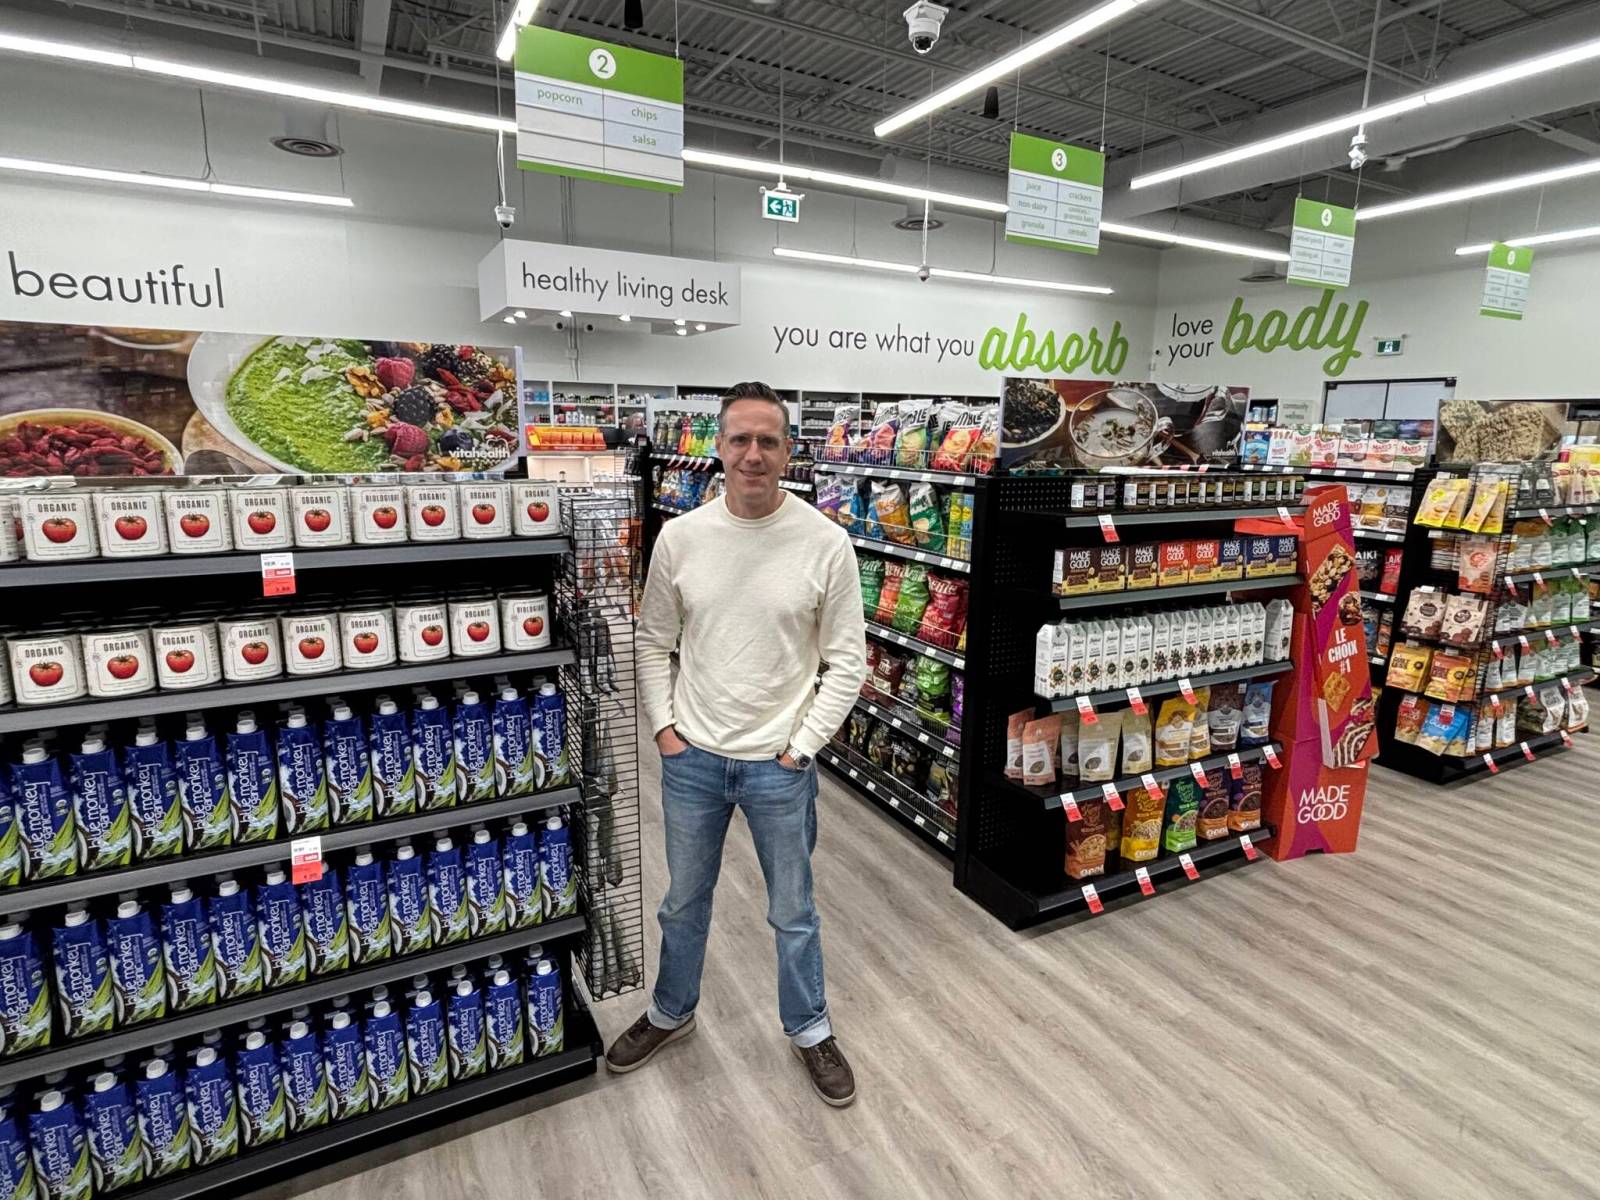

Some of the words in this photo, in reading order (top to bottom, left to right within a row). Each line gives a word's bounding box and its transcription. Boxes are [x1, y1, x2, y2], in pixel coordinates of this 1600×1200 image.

[596, 54, 609, 74] 2
[537, 87, 584, 106] popcorn
[631, 106, 658, 122] chips
[632, 132, 657, 147] salsa
[1055, 152, 1064, 167] 3
[8, 250, 225, 309] beautiful
[522, 261, 609, 302] healthy
[617, 270, 673, 308] living
[681, 278, 729, 306] desk
[1172, 313, 1213, 338] love
[1221, 288, 1370, 377] body
[773, 325, 819, 354] you
[828, 328, 868, 350] are
[875, 323, 931, 356] what
[937, 337, 975, 364] you
[978, 311, 1130, 376] absorb
[1168, 338, 1215, 367] your
[448, 446, 511, 459] vitahealth
[176, 499, 211, 510] ORGANIC
[244, 497, 276, 507] ORGANIC
[301, 495, 332, 505] ORGANIC
[418, 492, 447, 501] ORGANIC
[470, 491, 497, 500] ORGANIC
[525, 489, 551, 498] ORGANIC
[38, 503, 77, 513] ORGANIC
[110, 500, 148, 511] ORGANIC
[1312, 499, 1340, 518] MADE
[1313, 510, 1341, 527] GOOD
[1135, 546, 1153, 556] MADE
[1166, 544, 1184, 553] MADE
[1196, 542, 1214, 551] MADE
[1223, 540, 1240, 549] MADE
[1223, 547, 1240, 557] GOOD
[1252, 538, 1269, 547] MADE
[1252, 545, 1269, 555] GOOD
[1278, 537, 1295, 545] MADE
[1278, 543, 1295, 553] GOOD
[1070, 551, 1092, 561] MADE
[1100, 548, 1120, 558] MADE
[1100, 557, 1120, 567] GOOD
[1135, 554, 1153, 564] GOOD
[1166, 551, 1184, 561] GOOD
[1196, 550, 1214, 559] GOOD
[1355, 550, 1377, 560] AIKI
[1069, 560, 1090, 570] GOOD
[350, 619, 380, 629] ORGANIC
[419, 611, 444, 622] ORGANIC
[465, 608, 491, 618] ORGANIC
[238, 627, 269, 639] ORGANIC
[295, 623, 326, 634] ORGANIC
[1335, 627, 1348, 644] LE
[103, 639, 139, 652] ORGANIC
[162, 635, 195, 646] ORGANIC
[25, 646, 64, 658] ORGANIC
[1327, 640, 1359, 664] CHOIX
[1339, 660, 1351, 674] #1
[504, 713, 524, 757] monkey
[543, 708, 561, 750] monkey
[381, 728, 402, 775] monkey
[422, 723, 443, 769] monkey
[464, 718, 484, 763] monkey
[290, 742, 313, 789] monkey
[336, 735, 357, 783] monkey
[507, 757, 518, 780] blue
[546, 750, 557, 773] blue
[187, 756, 210, 805] monkey
[236, 749, 259, 799] monkey
[425, 769, 438, 792] blue
[467, 763, 479, 785] blue
[80, 770, 108, 819] monkey
[136, 762, 162, 811] monkey
[341, 783, 353, 806] blue
[385, 775, 397, 798] blue
[1299, 785, 1351, 807] MADE
[23, 781, 51, 831] monkey
[240, 799, 254, 823] blue
[296, 789, 309, 815] blue
[1297, 802, 1348, 824] GOOD
[144, 812, 158, 838] blue
[194, 806, 208, 831] blue
[88, 822, 102, 849] blue
[30, 833, 44, 861] blue
[514, 849, 532, 891] monkey
[549, 842, 567, 883] monkey
[438, 864, 457, 907] monkey
[476, 856, 495, 899] monkey
[358, 879, 378, 924] monkey
[399, 872, 419, 917] monkey
[267, 899, 289, 945] monkey
[312, 888, 333, 934] monkey
[172, 918, 197, 966] monkey
[220, 910, 243, 958] monkey
[65, 941, 91, 993] monkey
[117, 933, 144, 980] monkey
[0, 955, 27, 1006] monkey
